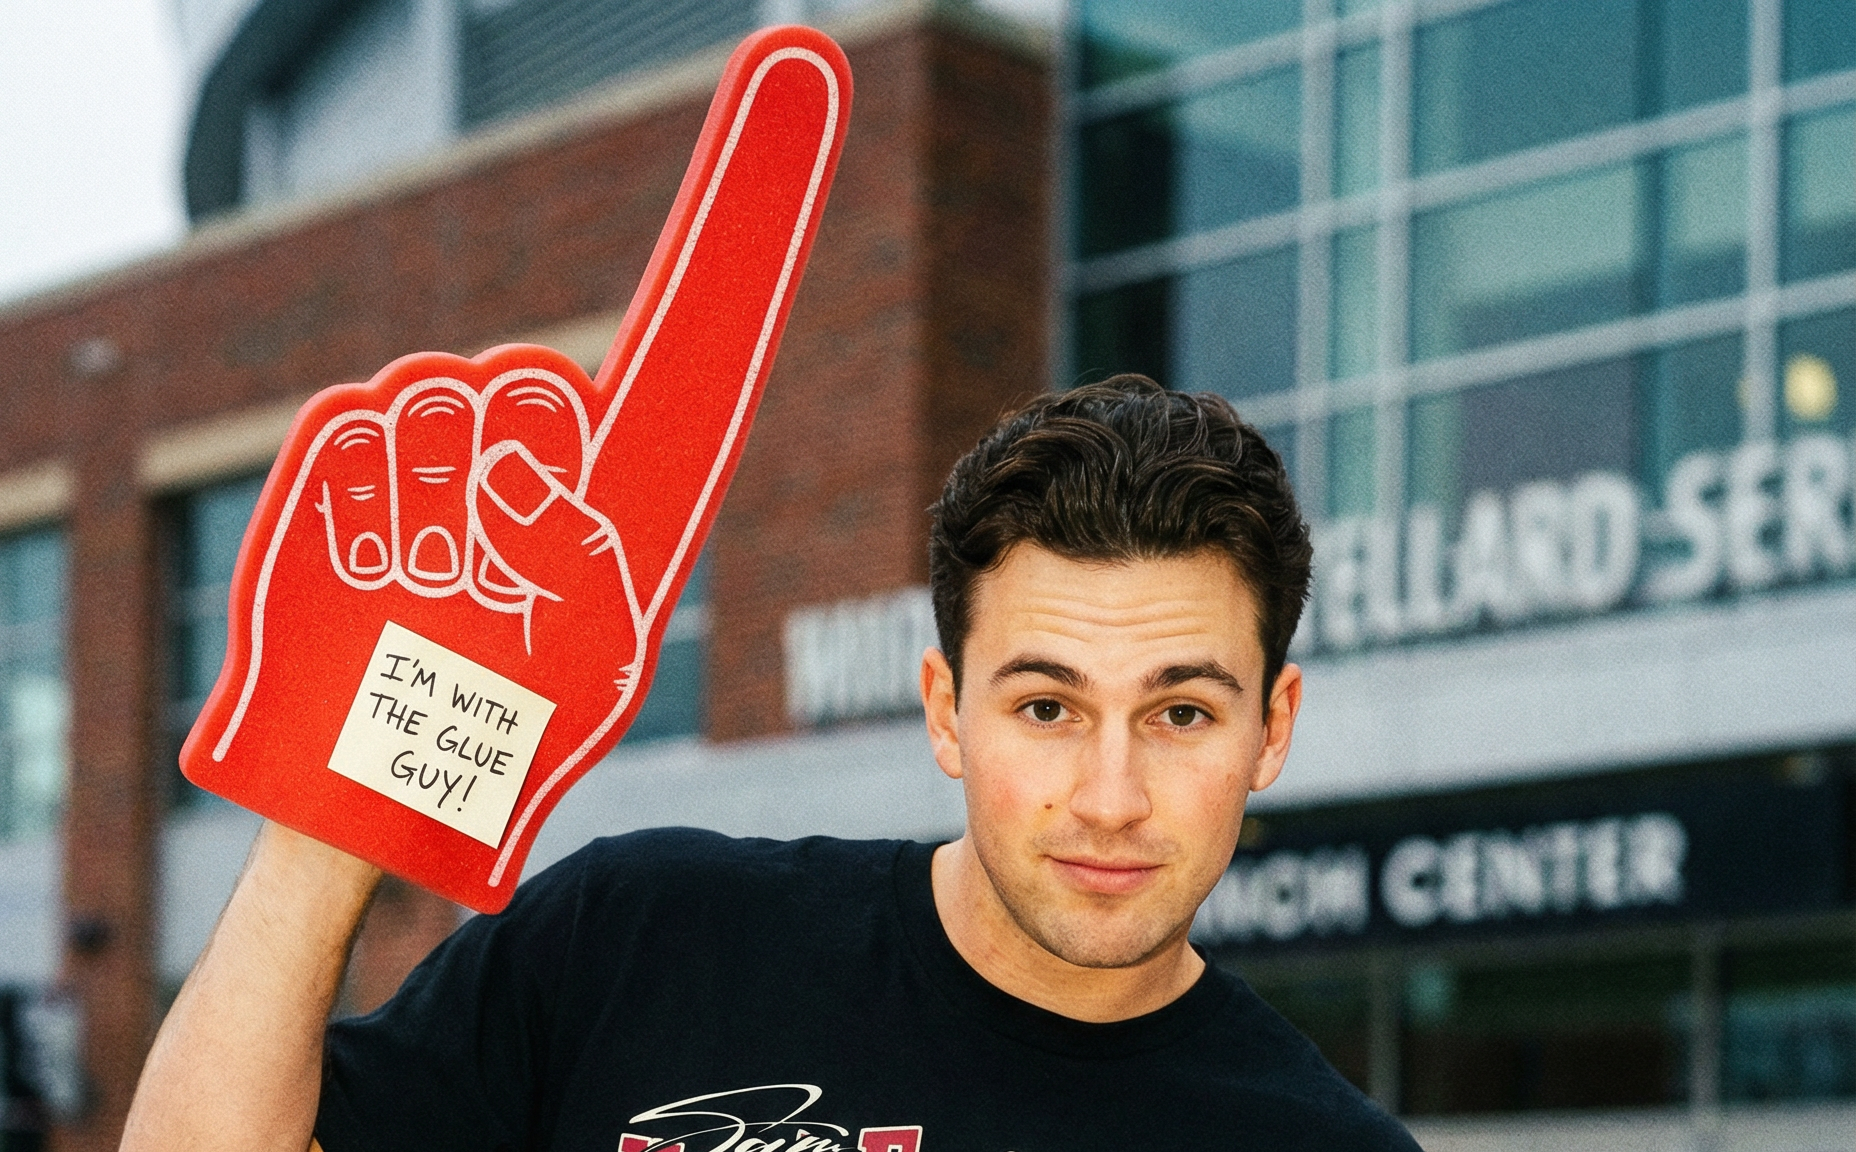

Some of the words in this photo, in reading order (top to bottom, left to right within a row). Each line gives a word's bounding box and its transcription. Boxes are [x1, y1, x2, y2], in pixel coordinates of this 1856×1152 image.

[370, 691, 428, 735] THE
[436, 725, 514, 776] GLUE
[380, 653, 436, 697] I'M
[452, 683, 518, 735] WITH
[390, 750, 477, 812] GUY!
[1380, 811, 1690, 928] CENTER
